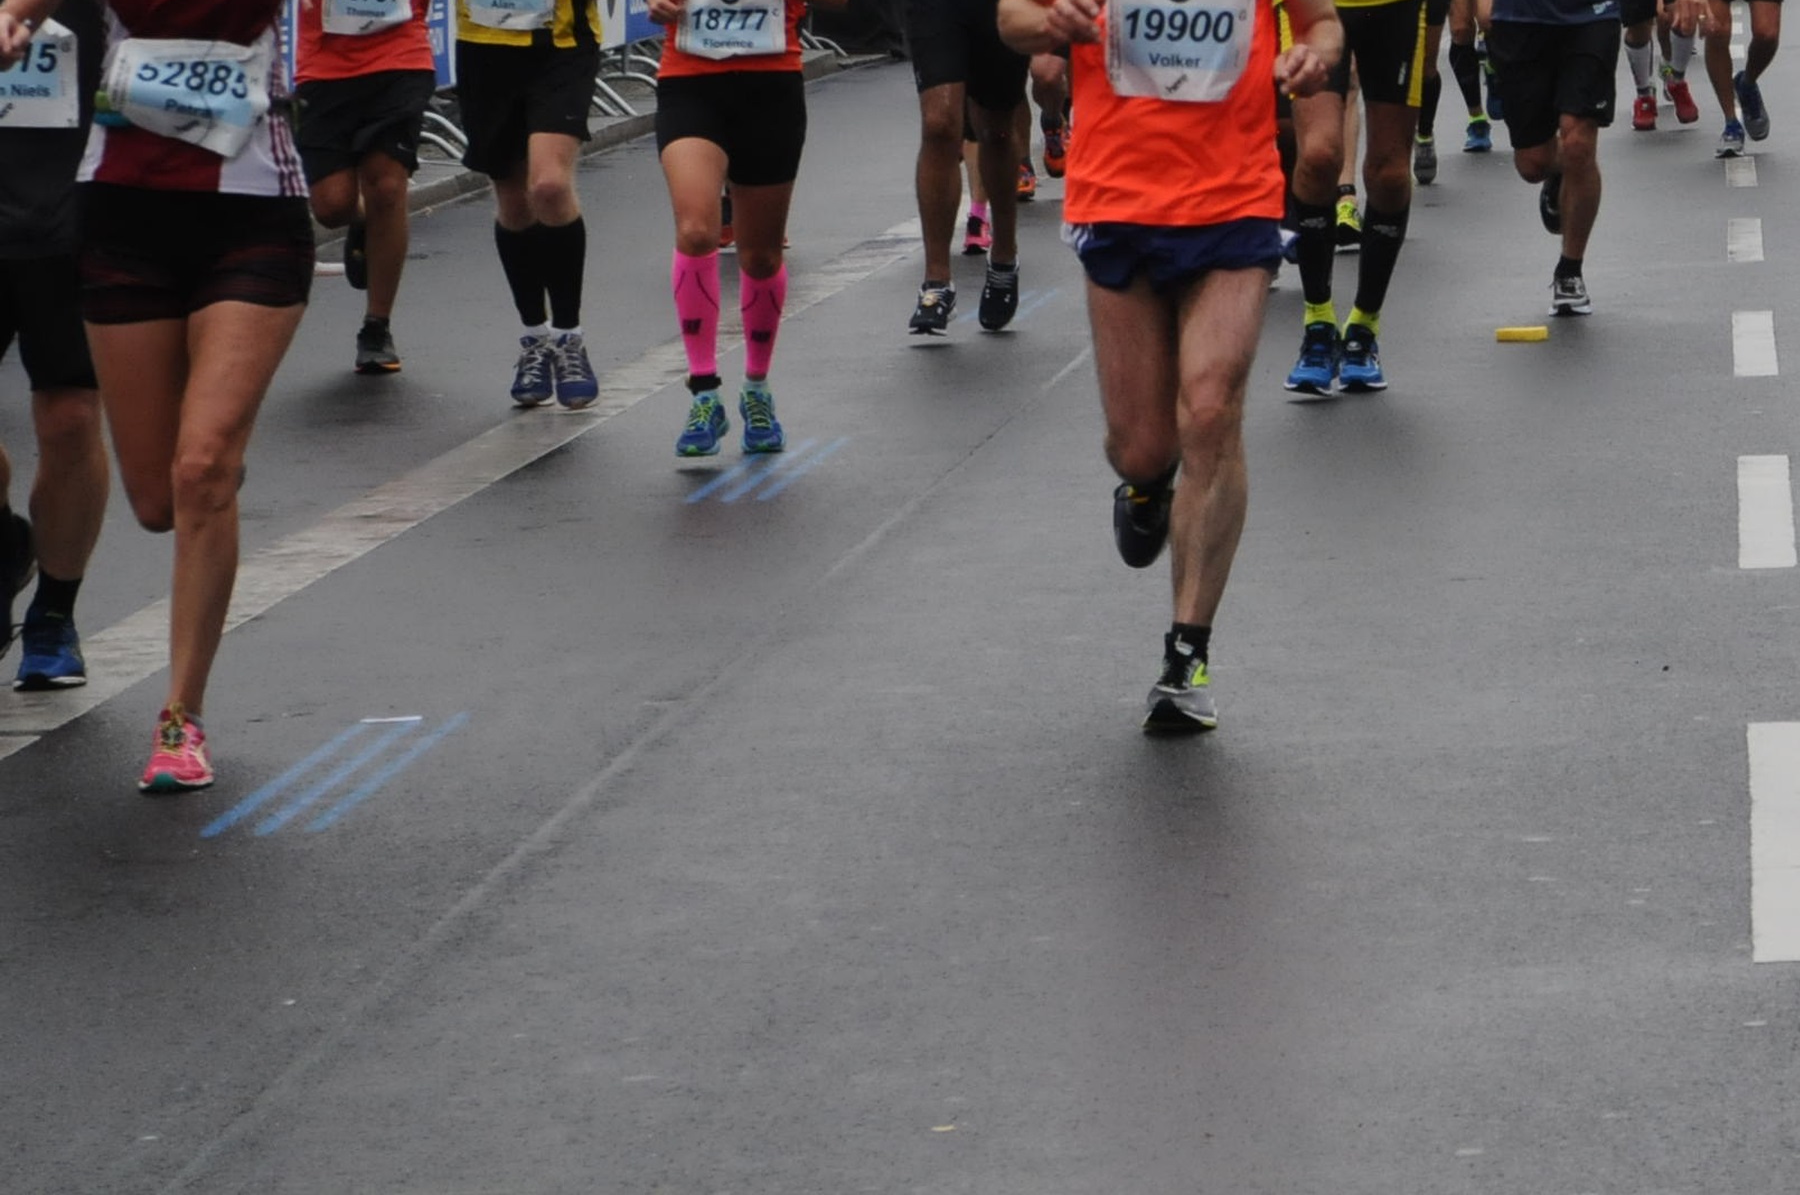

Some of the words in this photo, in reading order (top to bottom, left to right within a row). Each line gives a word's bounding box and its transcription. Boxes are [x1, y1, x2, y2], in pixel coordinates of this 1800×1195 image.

[691, 7, 769, 31] 18777
[1124, 7, 1235, 44] 19900
[702, 38, 754, 49] Florence
[1148, 52, 1201, 69] Volker
[137, 60, 248, 100] 52885
[10, 84, 51, 98] Niels
